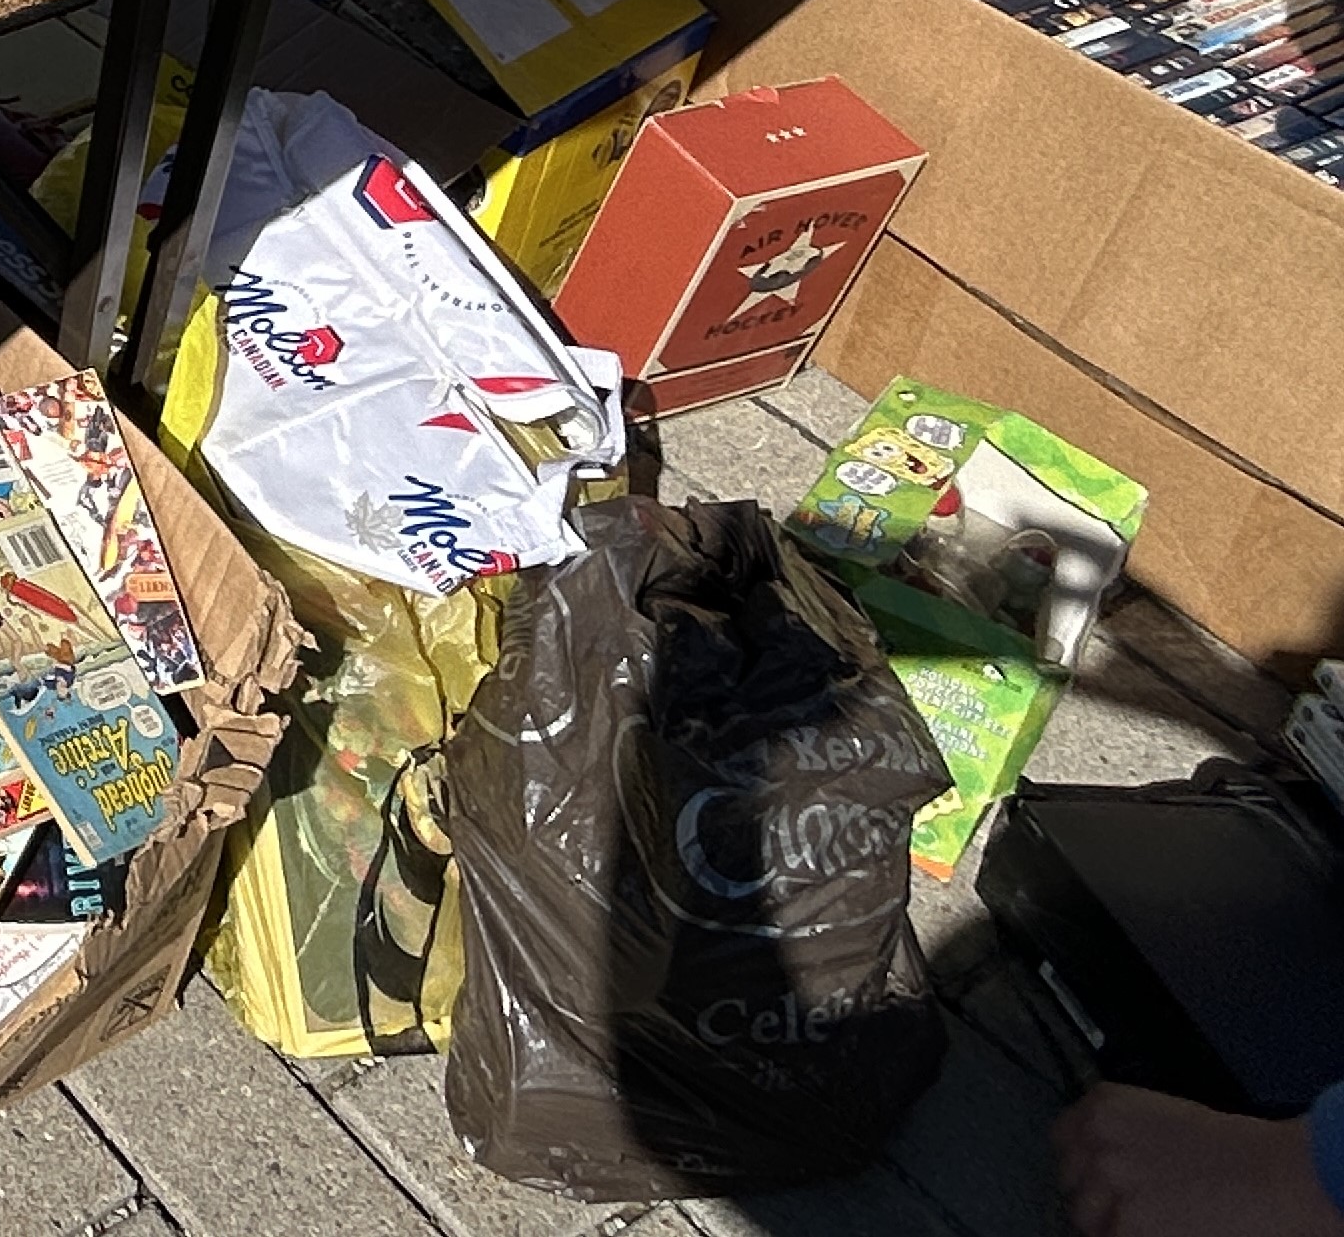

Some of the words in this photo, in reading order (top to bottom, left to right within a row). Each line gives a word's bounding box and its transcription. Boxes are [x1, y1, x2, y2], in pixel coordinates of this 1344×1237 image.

[739, 229, 785, 260] AIR
[793, 209, 869, 236] HOVER
[214, 264, 337, 392] Molson
[703, 304, 803, 342] HOCKEY
[230, 327, 289, 394] CANADIAN
[387, 474, 496, 580] Mol
[407, 540, 455, 594] CANAD
[46, 715, 129, 787] Archie
[92, 745, 174, 834] Jughead
